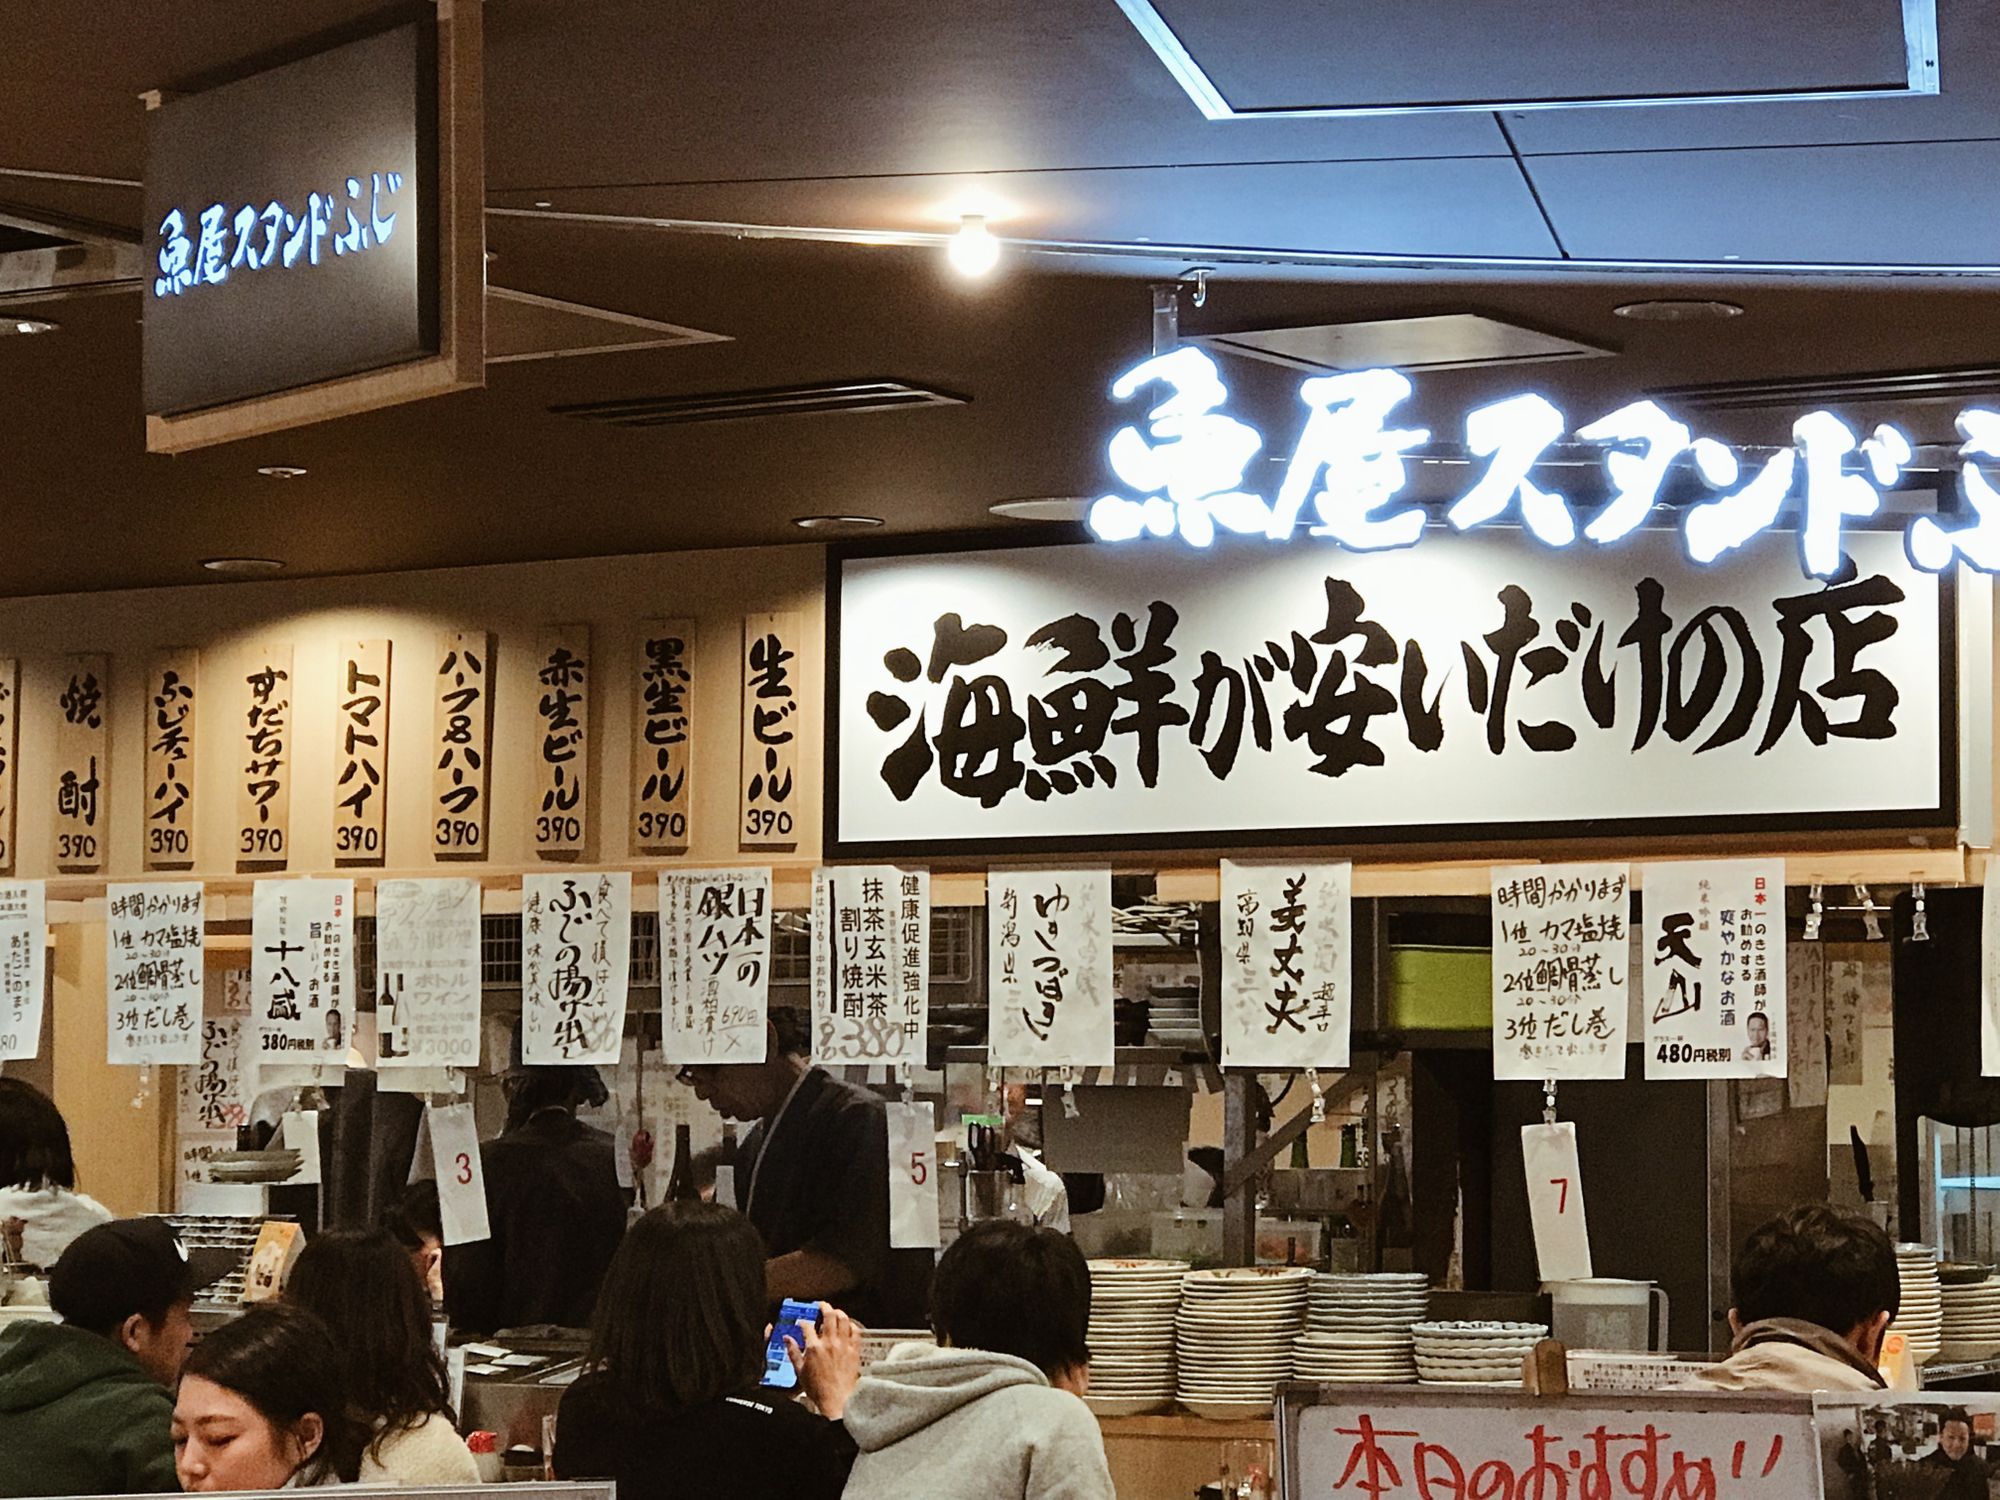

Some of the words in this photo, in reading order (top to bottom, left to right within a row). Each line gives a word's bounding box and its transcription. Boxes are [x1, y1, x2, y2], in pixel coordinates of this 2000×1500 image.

[154, 172, 402, 297] 魚屋スタンドふじ
[538, 648, 586, 812] 赤生ビール
[641, 638, 690, 802] 黒生ビール
[748, 633, 797, 803] 生ビール
[866, 560, 1908, 807] 海鮮が安いだけの店
[58, 673, 101, 826] 焼酎
[150, 671, 194, 824] ふじチューハイ
[245, 665, 289, 822] すだちサワー
[338, 659, 381, 818] トマトハイ
[58, 834, 96, 858] 390
[150, 829, 189, 854] 390
[241, 828, 282, 853] 390
[337, 826, 379, 851] 390
[436, 819, 479, 846] 390
[536, 817, 580, 842] 390
[638, 812, 686, 838] 390
[746, 809, 793, 835] 390
[731, 887, 765, 987] 日本一の
[840, 906, 865, 1018] 割り焼酎
[862, 877, 888, 1018] 抹茶玄米茶
[901, 875, 921, 1040] 健康促進強化中
[1539, 913, 1625, 943] カマ塩焼
[1653, 912, 1703, 1024] 天山
[1720, 909, 1735, 1026] 爽やかなお酒
[1740, 908, 1752, 981] お勧めする
[1754, 877, 1767, 1011] 日本一のきき酒師が
[262, 1034, 315, 1051] 380円税別
[1656, 1043, 1731, 1064] 480円税別
[455, 1153, 473, 1185] 3
[911, 1152, 927, 1185] 5
[1550, 1178, 1568, 1214] 7
